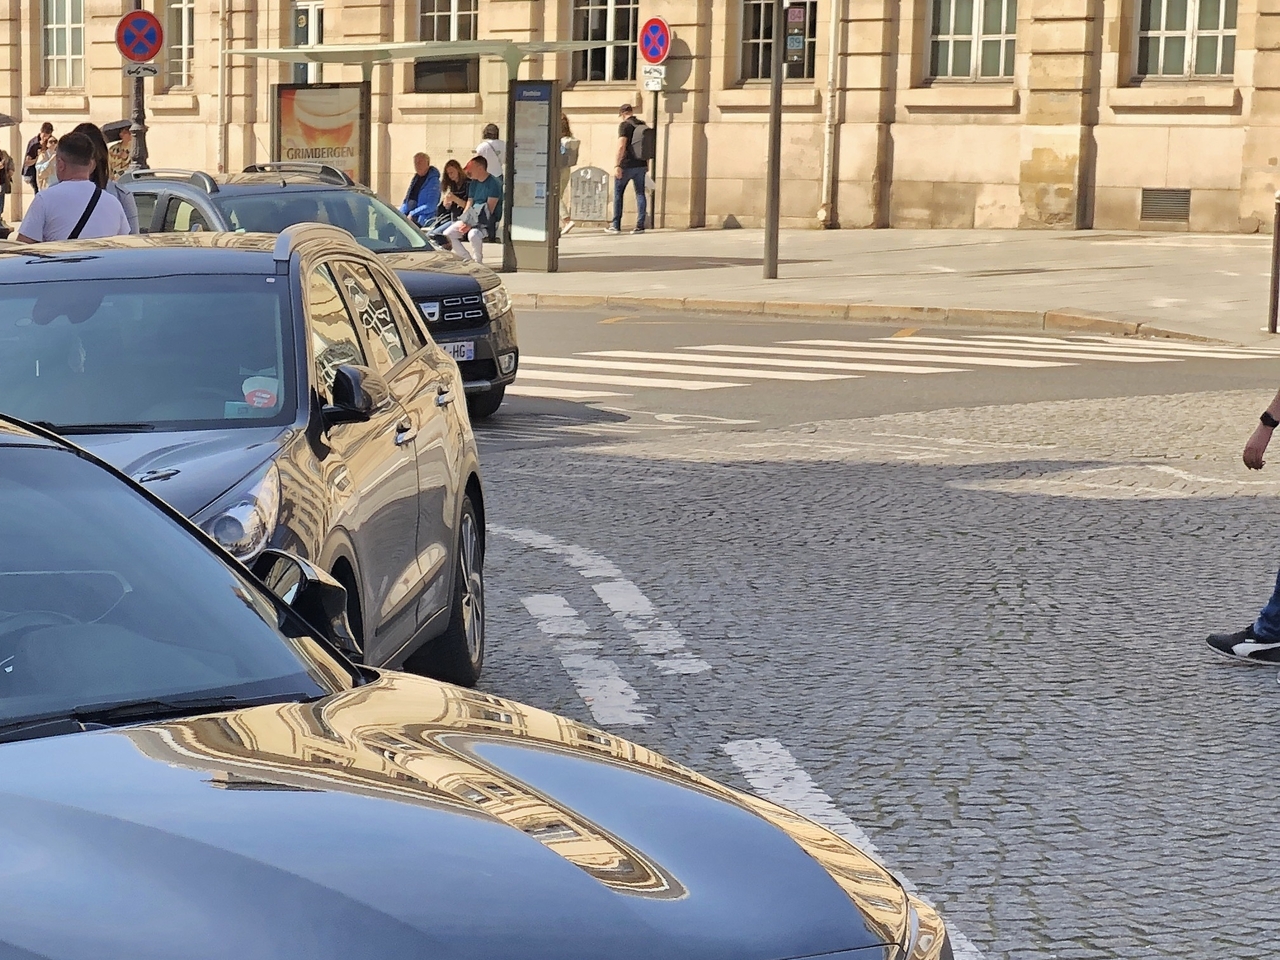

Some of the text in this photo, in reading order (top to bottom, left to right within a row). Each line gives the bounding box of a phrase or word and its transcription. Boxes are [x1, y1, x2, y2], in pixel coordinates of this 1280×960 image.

[789, 9, 802, 21] 84
[789, 37, 802, 48] 89
[286, 146, 355, 160] GRIMBERGEN
